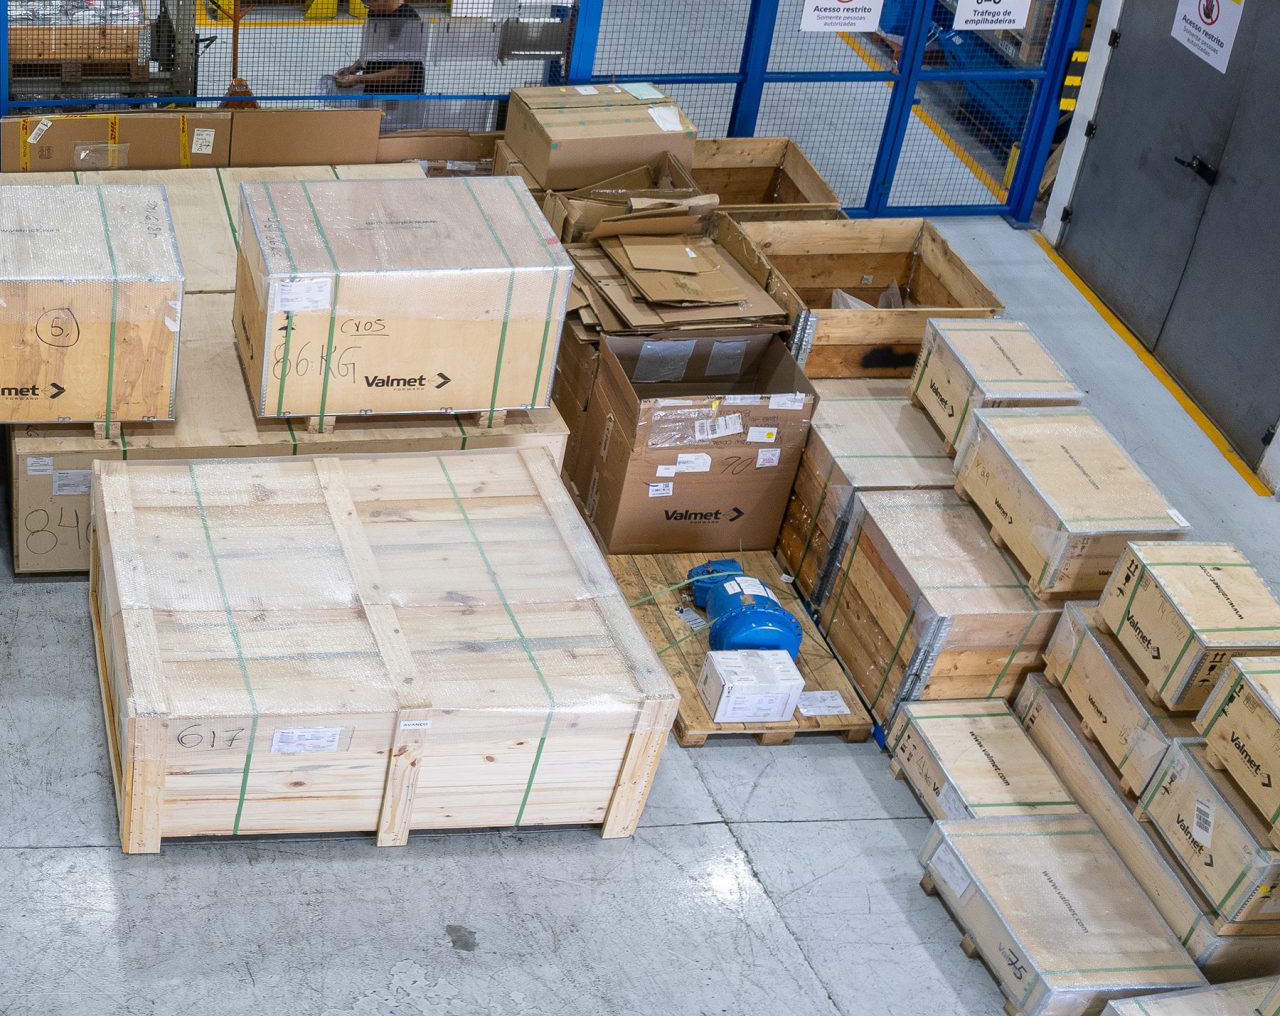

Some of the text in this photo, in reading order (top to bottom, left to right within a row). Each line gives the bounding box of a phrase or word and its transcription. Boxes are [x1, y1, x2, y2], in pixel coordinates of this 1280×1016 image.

[813, 5, 872, 13] Acesso restrito
[964, 17, 1016, 25] empilhadeiras
[972, 9, 1001, 18] Tráfego
[1182, 14, 1224, 48] Acesso restrito
[364, 375, 427, 388] Valmet
[929, 378, 949, 410] Valmet
[664, 510, 722, 521] Valmet
[994, 497, 1009, 519] Valmet
[1126, 609, 1152, 649] Valmet
[1088, 695, 1104, 718] Valmet
[177, 724, 245, 748] 617
[969, 731, 1010, 786] www.valmet.com
[1230, 731, 1261, 775] Valmet
[1176, 813, 1204, 854] Valmet
[1042, 870, 1089, 933] www.valmet.com
